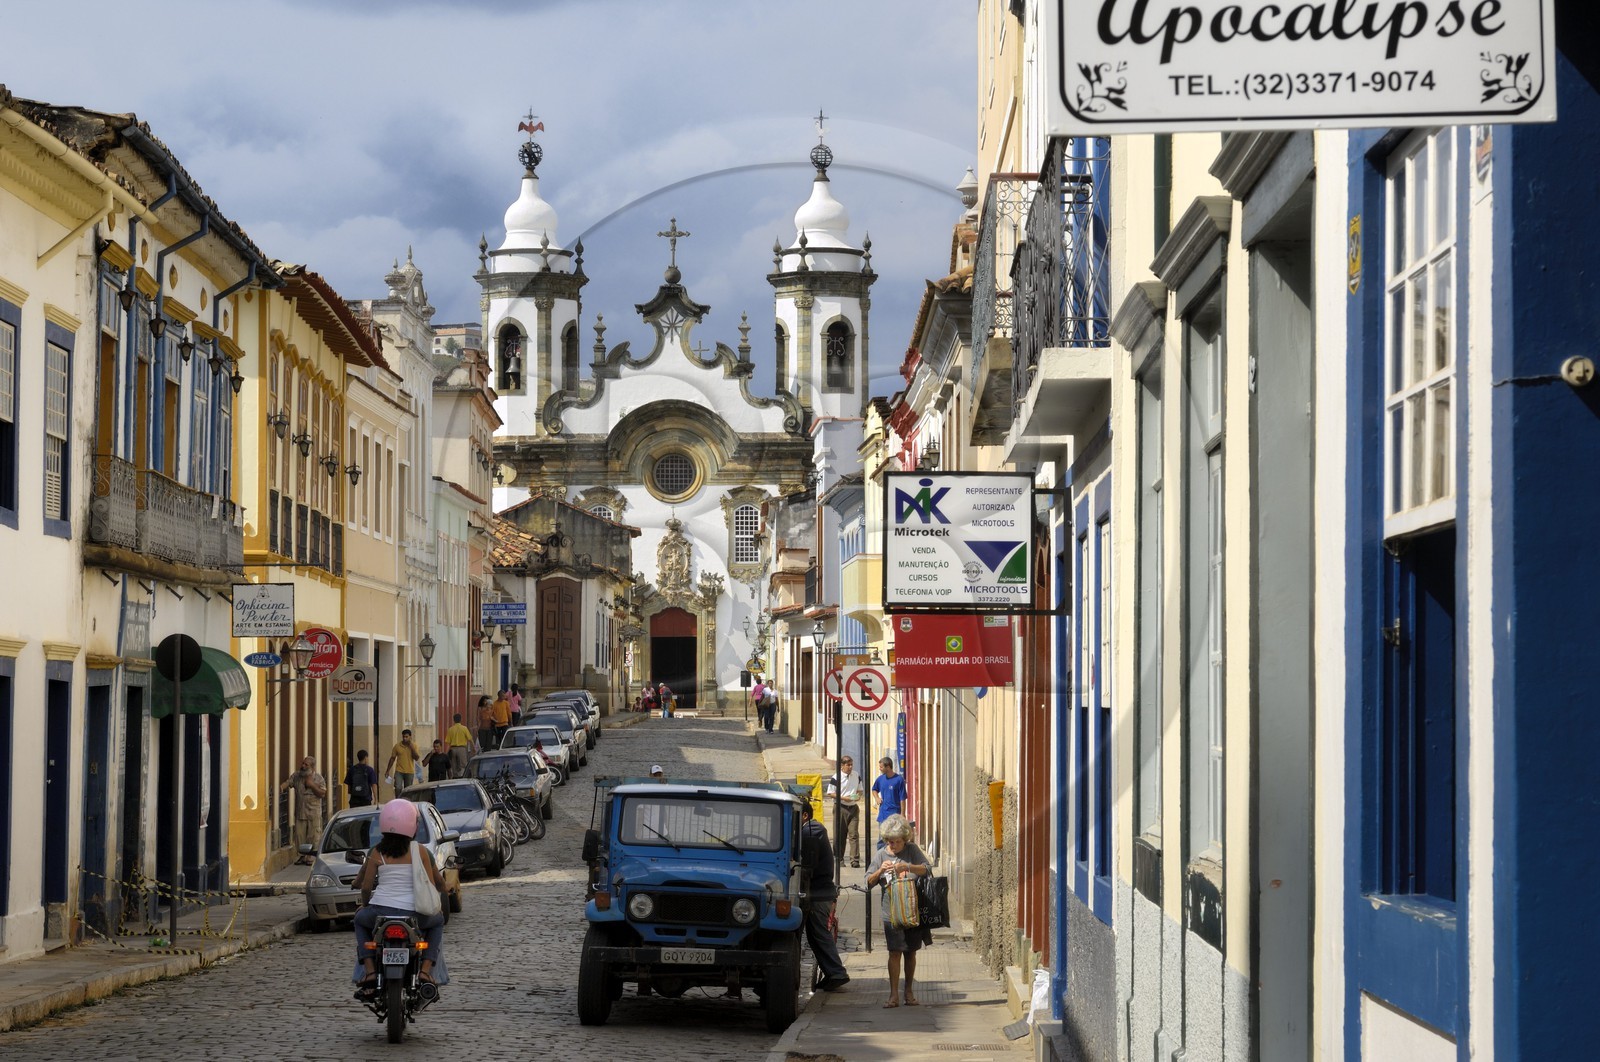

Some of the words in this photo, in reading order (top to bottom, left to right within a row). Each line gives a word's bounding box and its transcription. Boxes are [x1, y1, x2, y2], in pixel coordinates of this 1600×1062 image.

[1168, 70, 1436, 101] TEL.:(32)3371-9074
[965, 487, 1023, 495] REPRESENTANTE
[972, 503, 1015, 511] AUTORIZADA
[971, 519, 1015, 527] MICROTOOLS
[894, 527, 950, 537] Microtek
[898, 559, 950, 570] MANUTENÇÃO
[908, 574, 938, 582] CURSOS
[895, 588, 933, 596] TELEFONIA
[935, 588, 952, 596] VOIP
[963, 585, 1028, 594] MICROTOOLS
[896, 656, 933, 666] FARMÁCIA
[935, 656, 970, 665] POPULAR
[971, 656, 983, 664] DO
[984, 655, 1011, 664] BRASIL
[332, 679, 373, 692] Digitron
[663, 951, 687, 963] GQY
